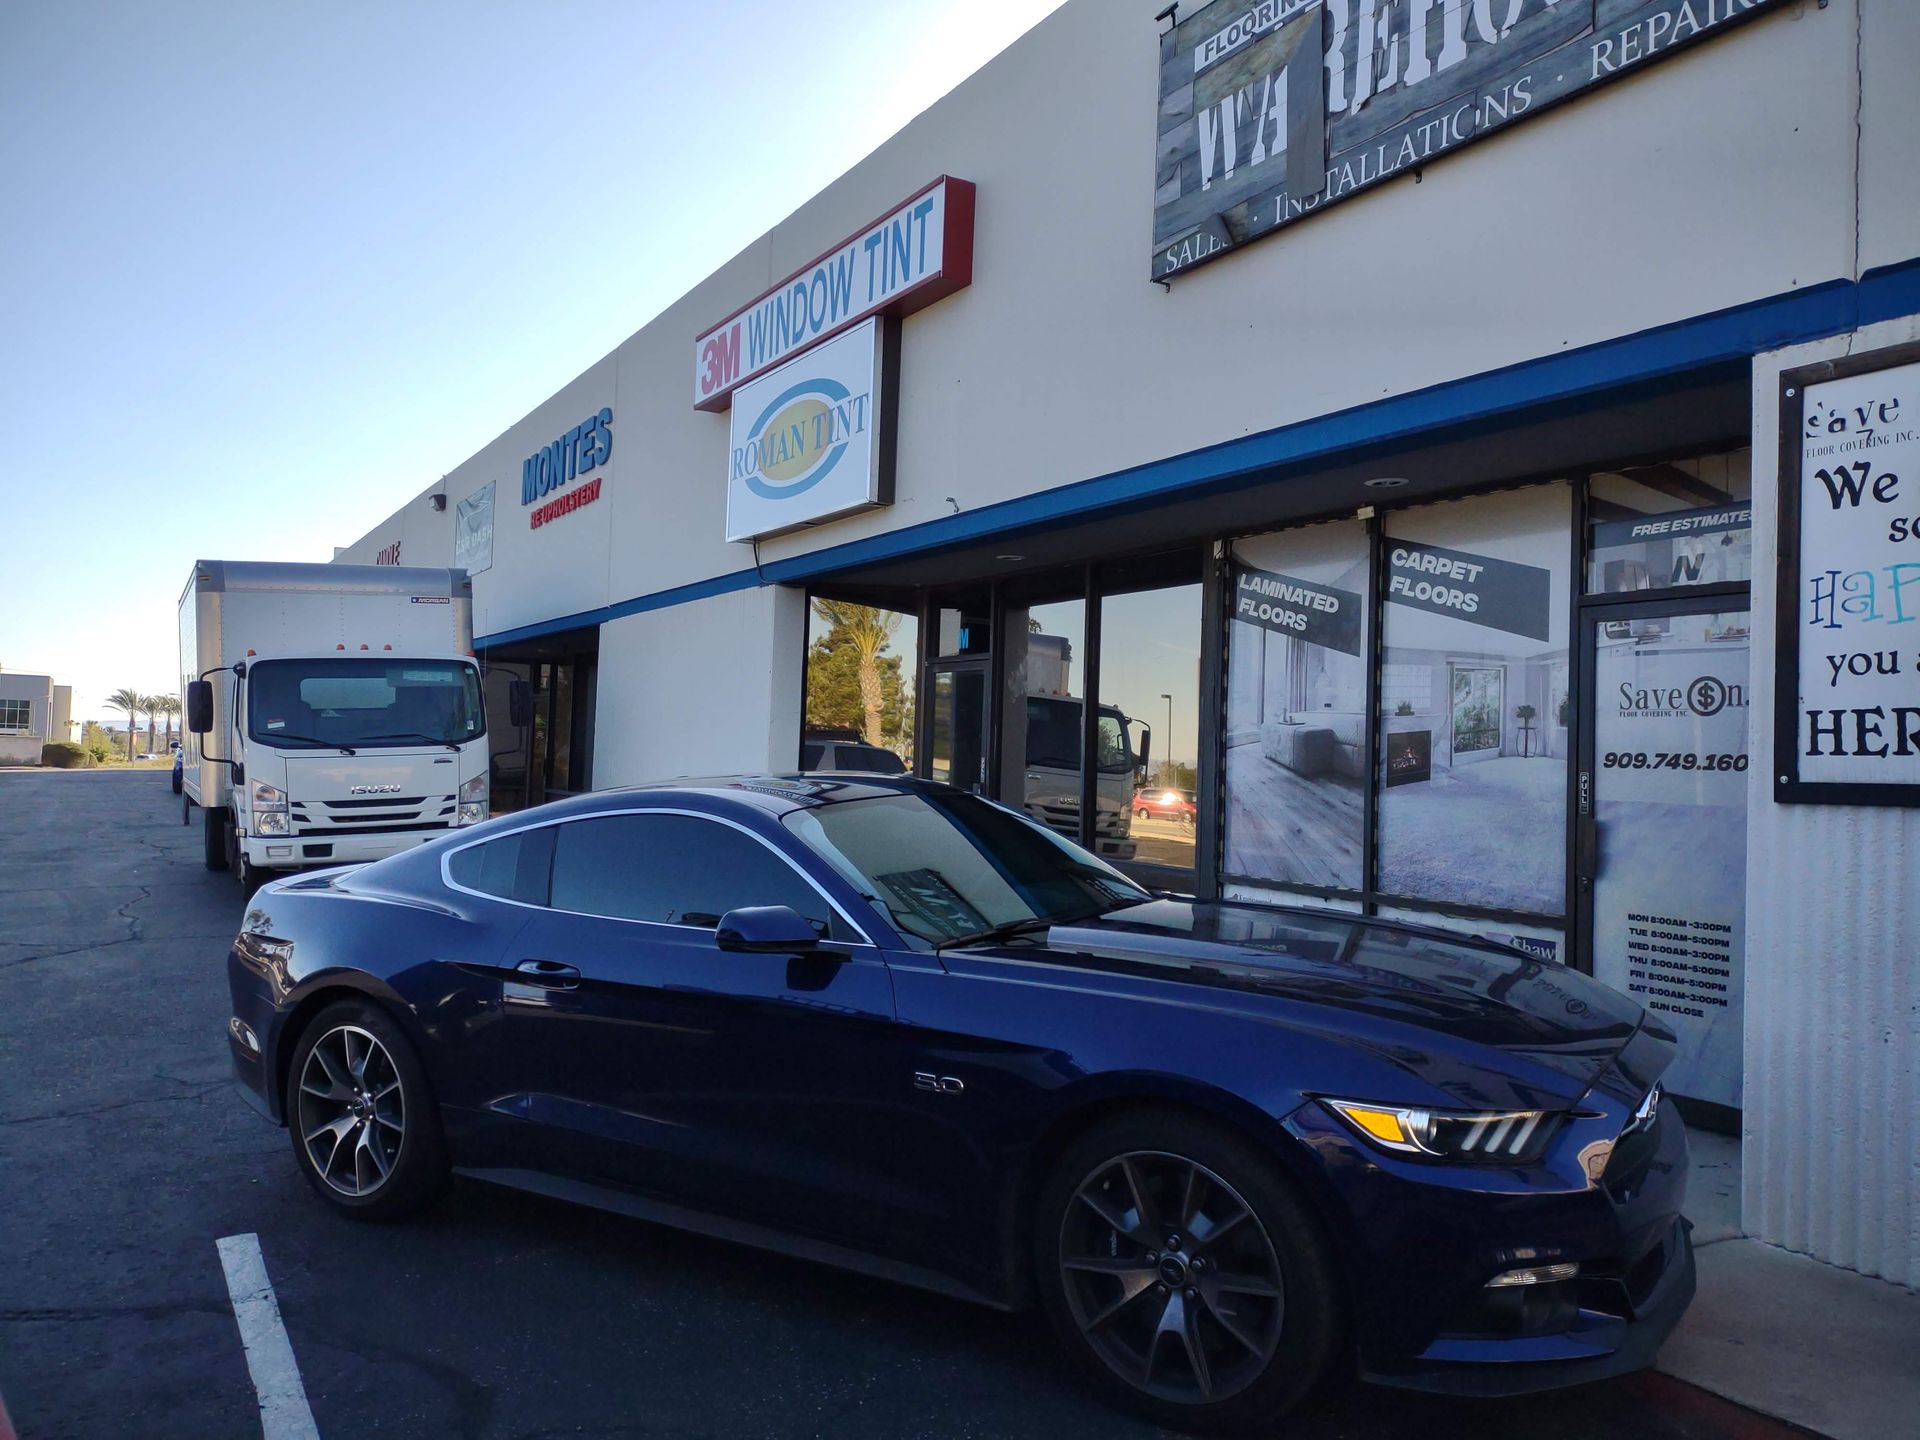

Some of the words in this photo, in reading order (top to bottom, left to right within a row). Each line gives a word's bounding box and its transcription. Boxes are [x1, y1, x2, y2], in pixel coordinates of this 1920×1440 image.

[1166, 232, 1228, 273] SALE
[1589, 0, 1766, 80] REPAI
[701, 322, 741, 394] 3M
[749, 247, 856, 369] WINDOW
[864, 196, 934, 302] TINT
[732, 420, 806, 481] ROMAN
[812, 392, 869, 449] TINT
[1806, 445, 1835, 458] FLOOR
[1840, 435, 1890, 453] COVERING
[1896, 430, 1920, 443] INC.
[521, 407, 613, 506] MONTES
[1814, 461, 1899, 510] We
[1631, 521, 1670, 538] FREE
[1671, 509, 1752, 532] ESTIMATE
[1391, 548, 1484, 583] CARPET
[1239, 573, 1340, 614] LAMINATED
[1389, 575, 1479, 613] FLOORS
[1238, 598, 1308, 631] FLOORS
[1826, 650, 1901, 687] you
[1619, 682, 1683, 711] Save
[351, 784, 401, 795] ISUZU
[1628, 913, 1649, 923] MON
[1629, 927, 1648, 937] TUE
[1512, 937, 1555, 960] Shaw
[1628, 941, 1649, 951] WED
[1628, 955, 1648, 964] THU
[1629, 983, 1648, 993] SAT
[1630, 969, 1645, 978] FRI
[1649, 1001, 1670, 1011] SUN
[1671, 1005, 1704, 1018] CLOSE
